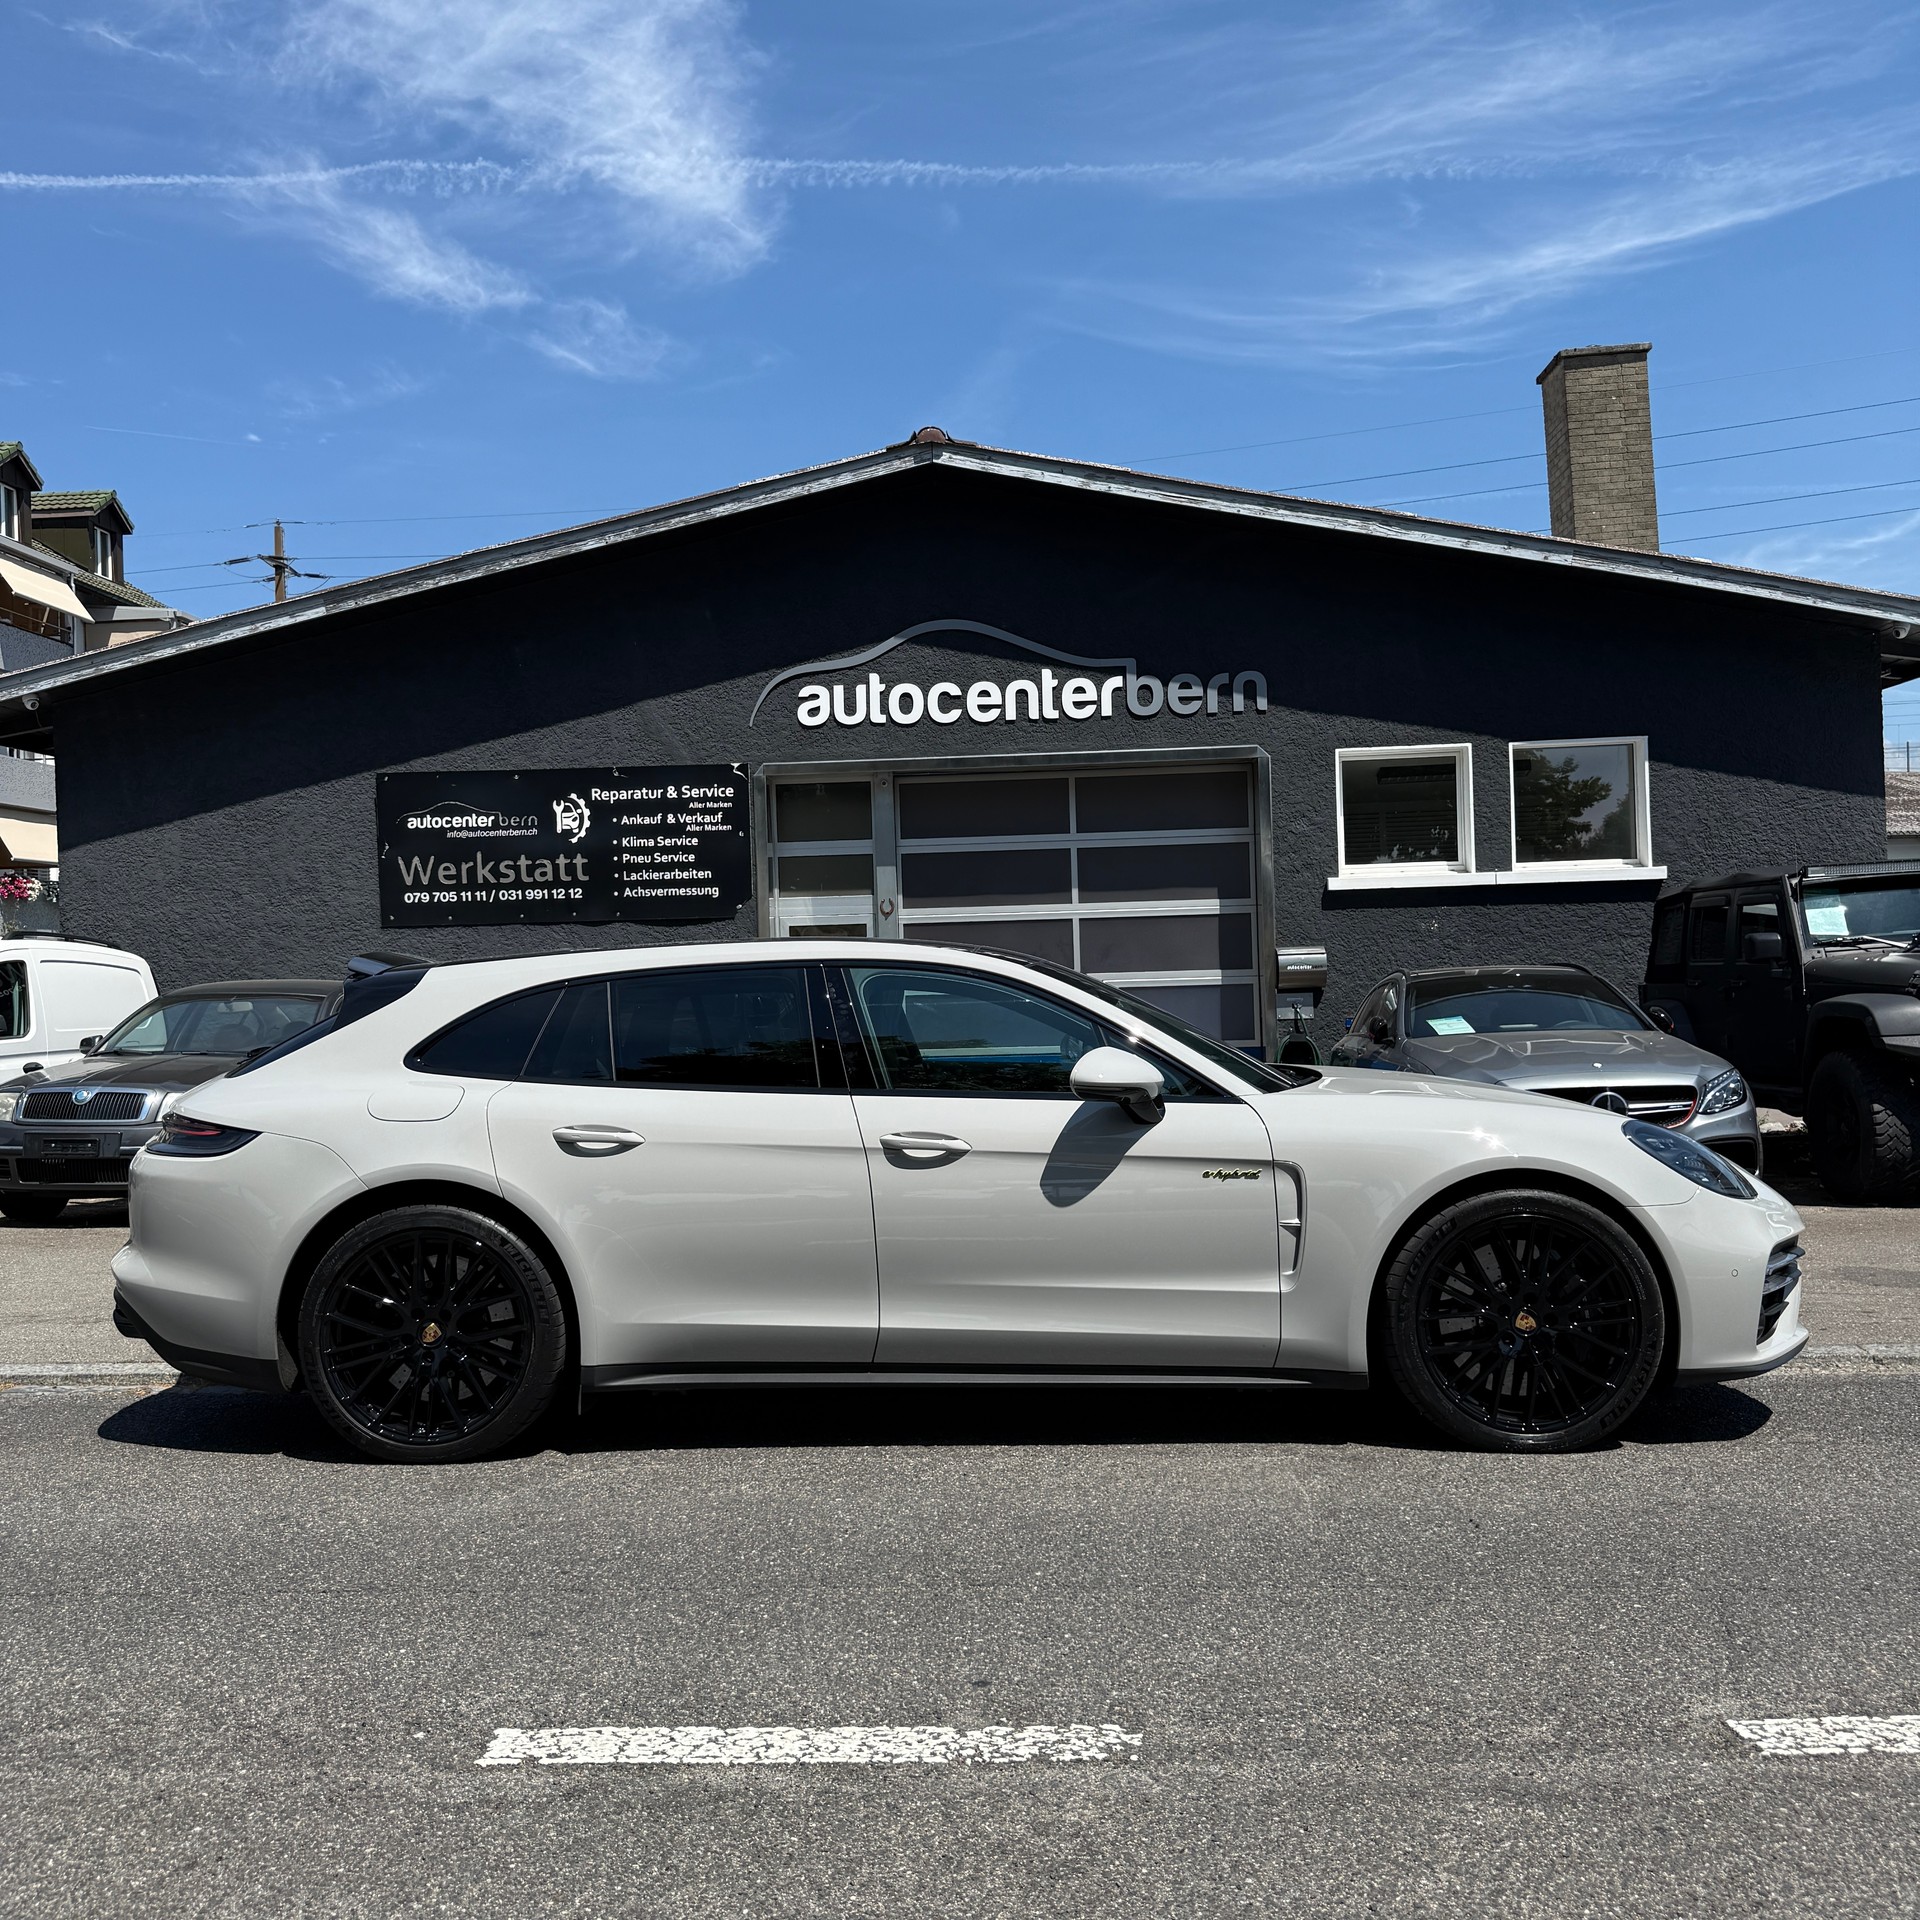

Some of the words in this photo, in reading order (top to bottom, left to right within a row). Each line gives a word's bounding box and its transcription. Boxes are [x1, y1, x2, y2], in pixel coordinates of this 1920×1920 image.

[591, 787, 663, 804] Reparatur
[666, 785, 678, 798] &
[681, 784, 734, 798] Service
[621, 813, 662, 825] Ankauf
[666, 813, 676, 824] &
[677, 812, 723, 824] Verkauf
[446, 828, 538, 838] info@autocenterbern.ch
[686, 824, 703, 832] Aller
[622, 836, 655, 847] Klima
[657, 835, 699, 846] Service
[622, 853, 651, 864] Pneu
[653, 851, 696, 863] Service
[398, 851, 590, 886] Werkstatt
[623, 868, 712, 881] Lackierarbeiten
[404, 892, 430, 904] 079
[433, 891, 458, 903] 705
[499, 889, 522, 900] 031
[525, 889, 549, 900] 991
[551, 889, 566, 899] 12
[568, 888, 583, 899] 12
[623, 886, 719, 898] Achsvermessung
[502, 1241, 551, 1323] MICHELIN
